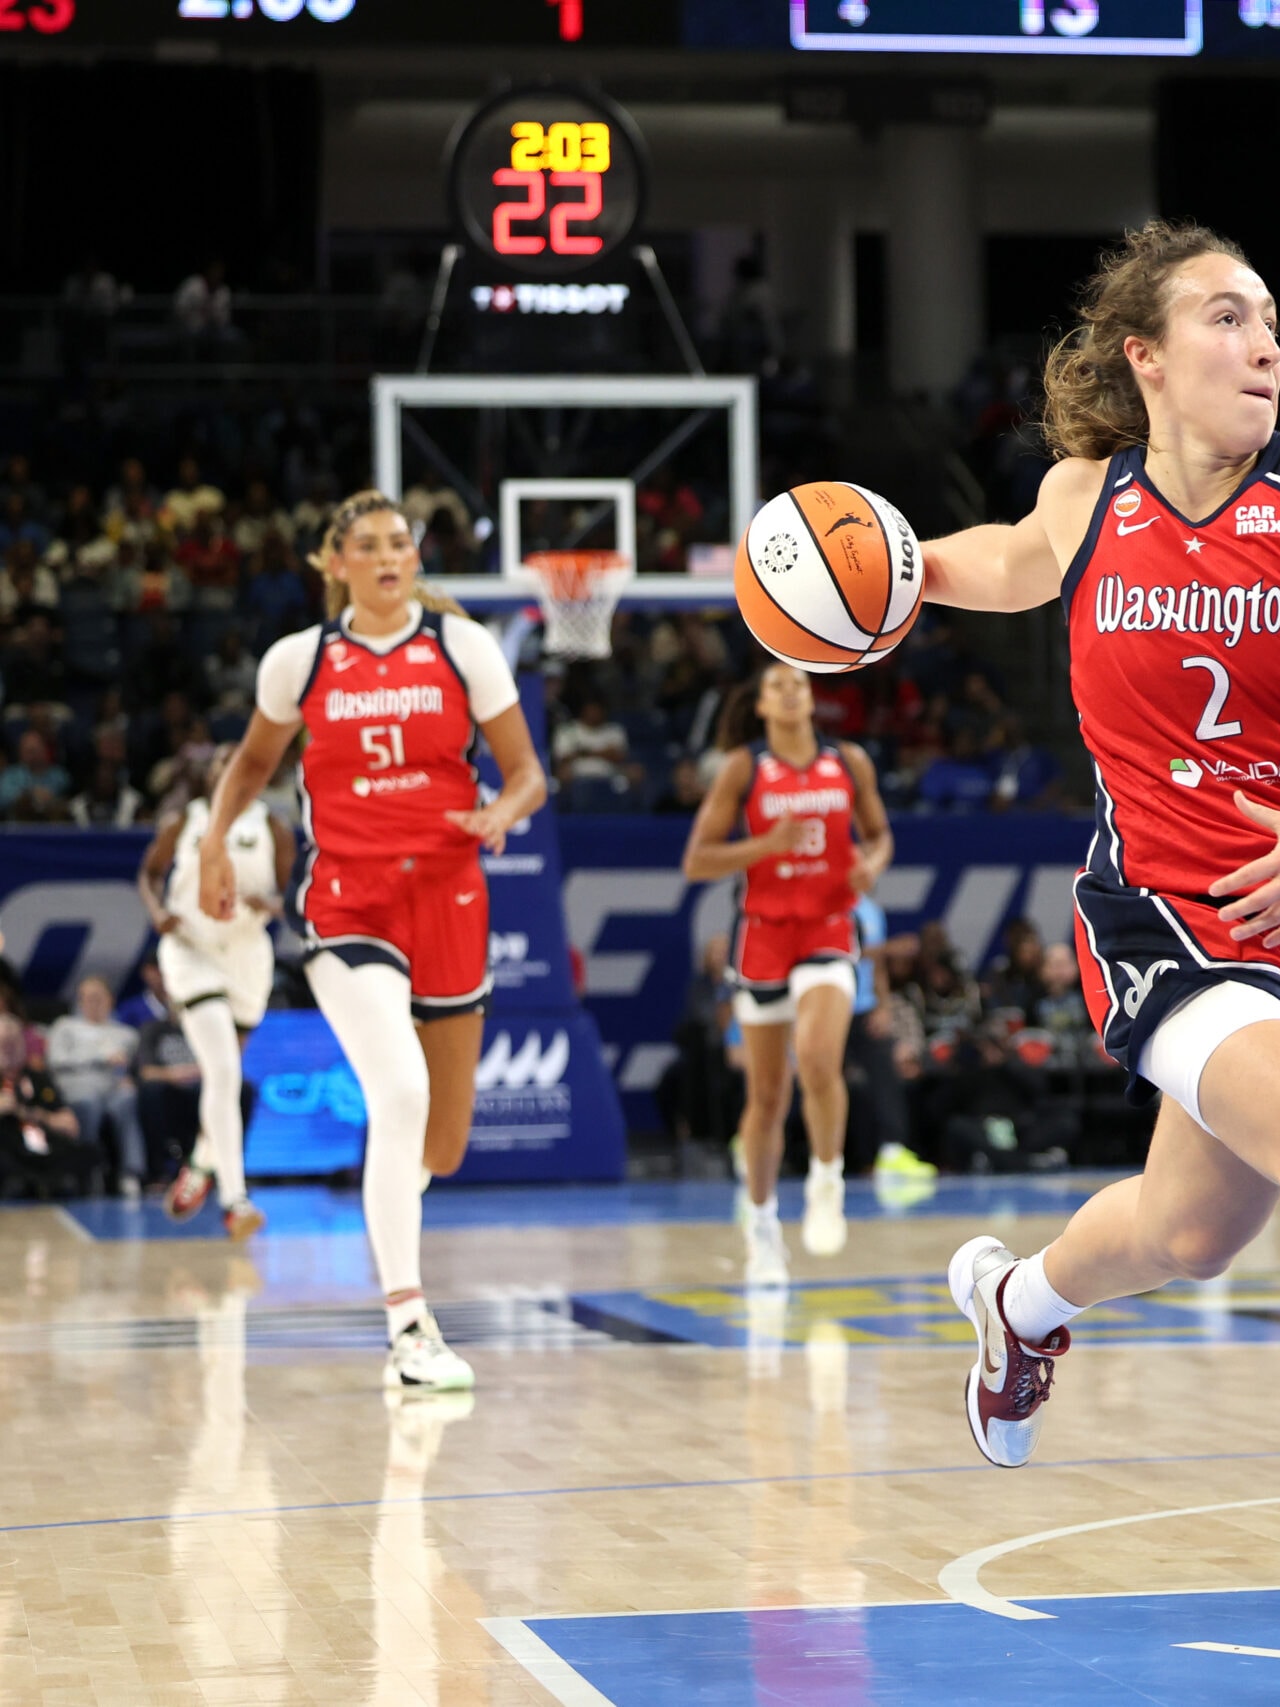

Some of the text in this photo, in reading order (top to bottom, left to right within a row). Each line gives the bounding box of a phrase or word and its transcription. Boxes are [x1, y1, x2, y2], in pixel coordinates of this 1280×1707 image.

[511, 121, 611, 173] 2:03
[492, 168, 604, 255] 22
[1235, 505, 1276, 520] CAR
[325, 685, 444, 722] Washington
[1182, 655, 1243, 741] 2
[360, 724, 406, 771] 51
